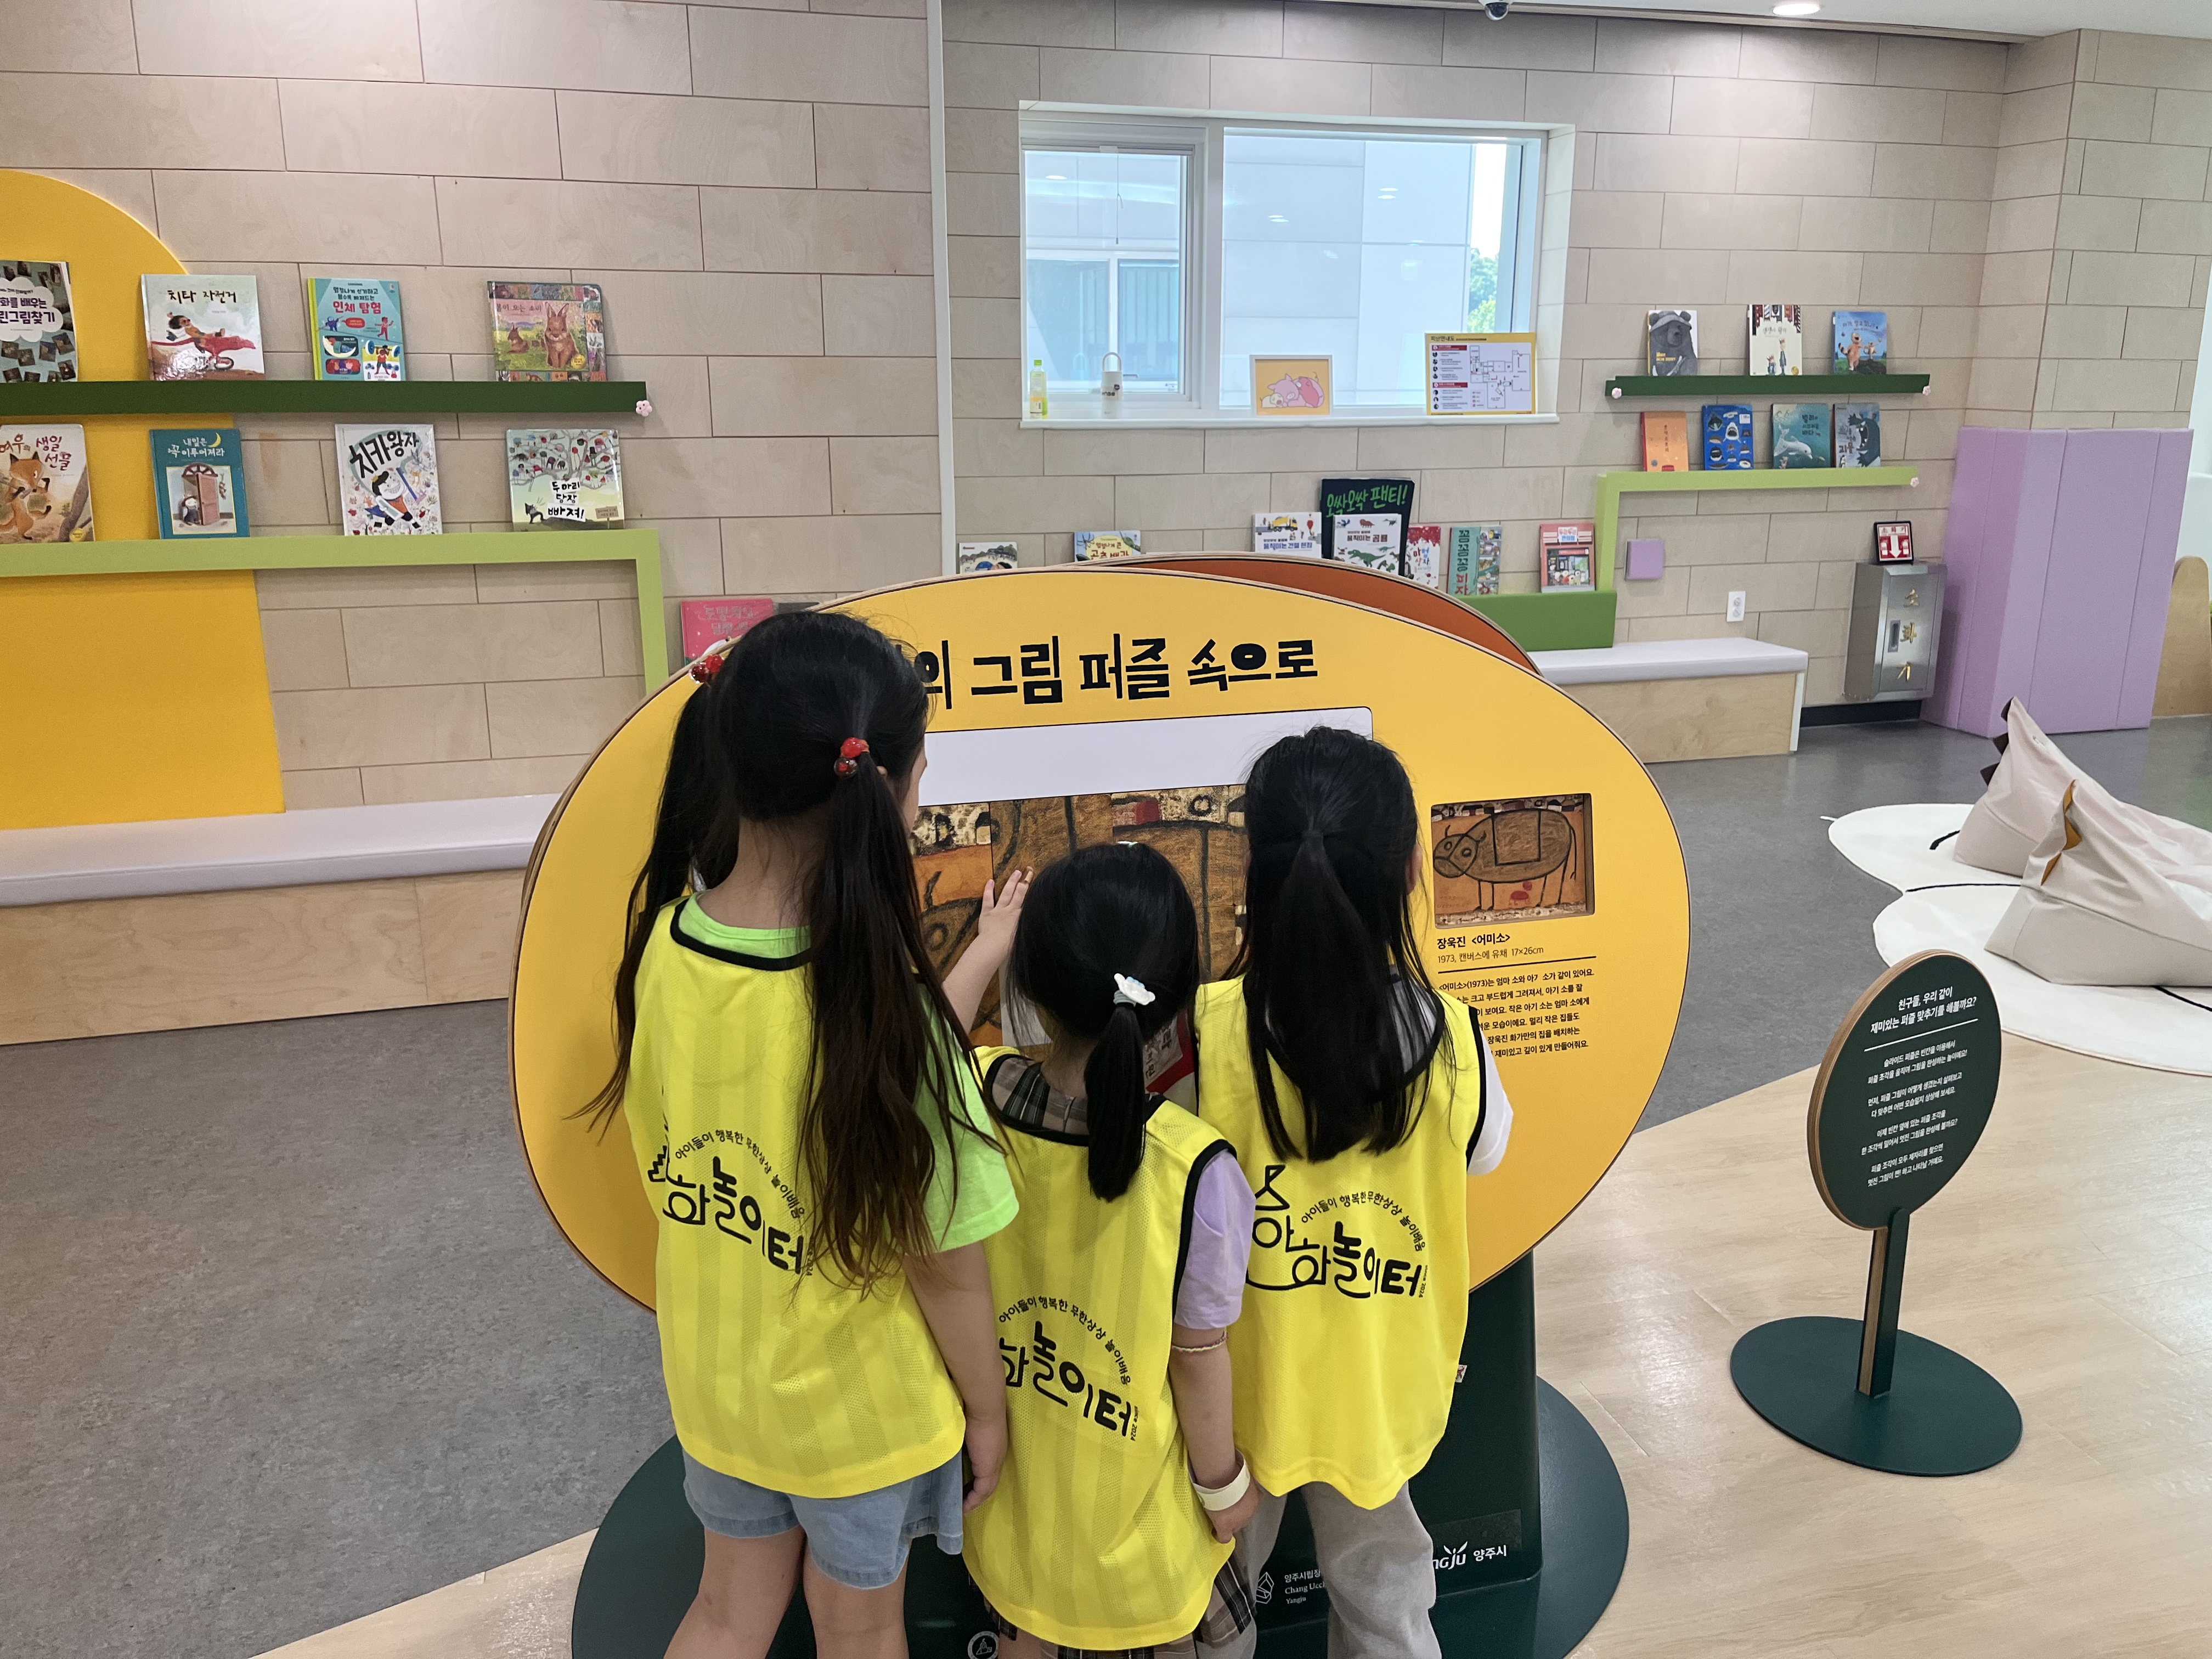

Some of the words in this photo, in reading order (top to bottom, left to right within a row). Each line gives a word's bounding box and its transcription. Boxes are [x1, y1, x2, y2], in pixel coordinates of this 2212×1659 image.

[20, 297, 47, 309] 배우는
[167, 290, 196, 304] 치타
[202, 290, 236, 303] 자전거
[333, 301, 356, 313] 인체
[359, 302, 381, 314] 탐험
[0, 433, 31, 454] 여우의
[36, 435, 63, 452] 생일
[168, 444, 180, 458] 꼭
[182, 448, 225, 458] 이루어져라
[183, 437, 207, 447] 내일은
[44, 452, 72, 471] 선물
[556, 493, 577, 503] 당장
[1370, 484, 1408, 509] 팬티!
[548, 506, 584, 519] 빠져!
[1455, 573, 1469, 596] 피자
[971, 635, 1063, 706] 그림
[1079, 633, 1170, 701] 퍼즐
[1187, 638, 1318, 692] 속으로
[1437, 935, 1466, 950] 장욱진
[1471, 933, 1510, 945] <어미소>
[1437, 954, 1457, 963] 1973,
[1459, 950, 1490, 962] 캔버스에
[1492, 948, 1508, 959] 유채
[1496, 977, 1510, 986] 엄마
[1512, 975, 1525, 984] 소와
[1542, 972, 1556, 980] 소가
[1558, 970, 1571, 980] 같이
[1572, 968, 1594, 978] 있어요.
[1470, 994, 1485, 1002] 크고
[1486, 991, 1513, 1001] 부드럽게
[1515, 987, 1544, 998] 그려져서,
[1545, 986, 1559, 995] 아기
[1561, 984, 1574, 993] 소를
[1576, 984, 1583, 992] 잘
[1898, 995, 1921, 1011] 친구들,
[1922, 990, 1937, 1004] 우리
[1938, 986, 1953, 1000] 같이
[1485, 1006, 1507, 1015] 보여요.
[1509, 1005, 1522, 1013] 작은
[1524, 1002, 1537, 1011] 아기
[1539, 1001, 1553, 1009] 소는
[1554, 998, 1568, 1008] 엄마
[1570, 996, 1589, 1006] 소에게
[1870, 1018, 1900, 1034] 재미있는
[1900, 1011, 1916, 1025] 퍼즐
[1917, 1005, 1945, 1022] 맞추기를
[1946, 996, 1977, 1013] 해볼까요?
[1529, 1015, 1543, 1026] 멀리
[1544, 1014, 1558, 1024] 작은
[1560, 1012, 1580, 1022] 집들도
[1487, 1034, 1508, 1045] 장욱진
[1509, 1031, 1537, 1042] 화가만의
[1538, 1029, 1551, 1039] 집을
[1553, 1026, 1581, 1036] 배치하는
[1495, 1047, 1522, 1058] 재미있고
[1523, 1045, 1537, 1054] 깊이
[1539, 1043, 1553, 1053] 있게
[1884, 1054, 1904, 1068] 슬라이드
[1905, 1050, 1920, 1061] 퍼즐은
[1920, 1046, 1936, 1057] 빈칸을
[1936, 1040, 1956, 1052] 이용해서
[1867, 1074, 1878, 1084] 퍼즐
[1878, 1070, 1894, 1081] 조각을
[1895, 1065, 1910, 1077] 움직여
[1911, 1060, 1926, 1071] 그림을
[1927, 1056, 1946, 1068] 완성하는
[1880, 1092, 1891, 1102] 퍼즐
[1891, 1087, 1907, 1099] 그림이
[1908, 1083, 1922, 1094] 어떻게
[1923, 1077, 1943, 1090] 생겼는지
[1943, 1072, 1962, 1084] 살펴보고
[1871, 1110, 1877, 1118] 다
[1877, 1104, 1893, 1116] 맞추면
[1893, 1101, 1904, 1111] 어떤
[1905, 1095, 1925, 1108] 모습일지
[1925, 1090, 1940, 1102] 상상해
[1877, 1127, 1887, 1137] 이제
[1888, 1124, 1898, 1135] 빈칸
[1910, 1118, 1920, 1128] 있는
[1920, 1114, 1931, 1124] 퍼즐
[1931, 1109, 1946, 1120] 조각을
[1867, 1141, 1883, 1153] 조각씩
[1883, 1136, 1899, 1149] 밀어서
[1899, 1133, 1910, 1143] 멋진
[1910, 1128, 1925, 1139] 그림을
[1926, 1123, 1940, 1135] 완성해
[1871, 1163, 1882, 1173] 퍼즐
[1882, 1158, 1898, 1170] 조각이
[1909, 1148, 1928, 1161] 제자리를
[1928, 1143, 1944, 1155] 찾으면
[675, 1132, 714, 1159] 아이들이
[715, 1129, 744, 1146] 행복한
[745, 1137, 772, 1175] 무한상상
[771, 1174, 805, 1219] 놀이배움
[1867, 1177, 1878, 1187] 멋진
[1878, 1171, 1894, 1183] 그림이
[1901, 1166, 1912, 1175] 하고
[1912, 1160, 1928, 1171] 나타날
[1301, 1198, 1338, 1223] 아이들이
[1340, 1192, 1366, 1207] 행복한
[1367, 1191, 1403, 1216] 무한상상
[1399, 1215, 1426, 1252] 놀이배움
[998, 1296, 1037, 1323] 아이들이
[1039, 1295, 1068, 1312] 행복한
[1070, 1304, 1107, 1340] 무한상상
[1104, 1339, 1131, 1385] 놀이배움
[1473, 1544, 1506, 1562] 양주시
[1285, 1585, 1308, 1594] Chang
[1286, 1596, 1306, 1604] Yangju
